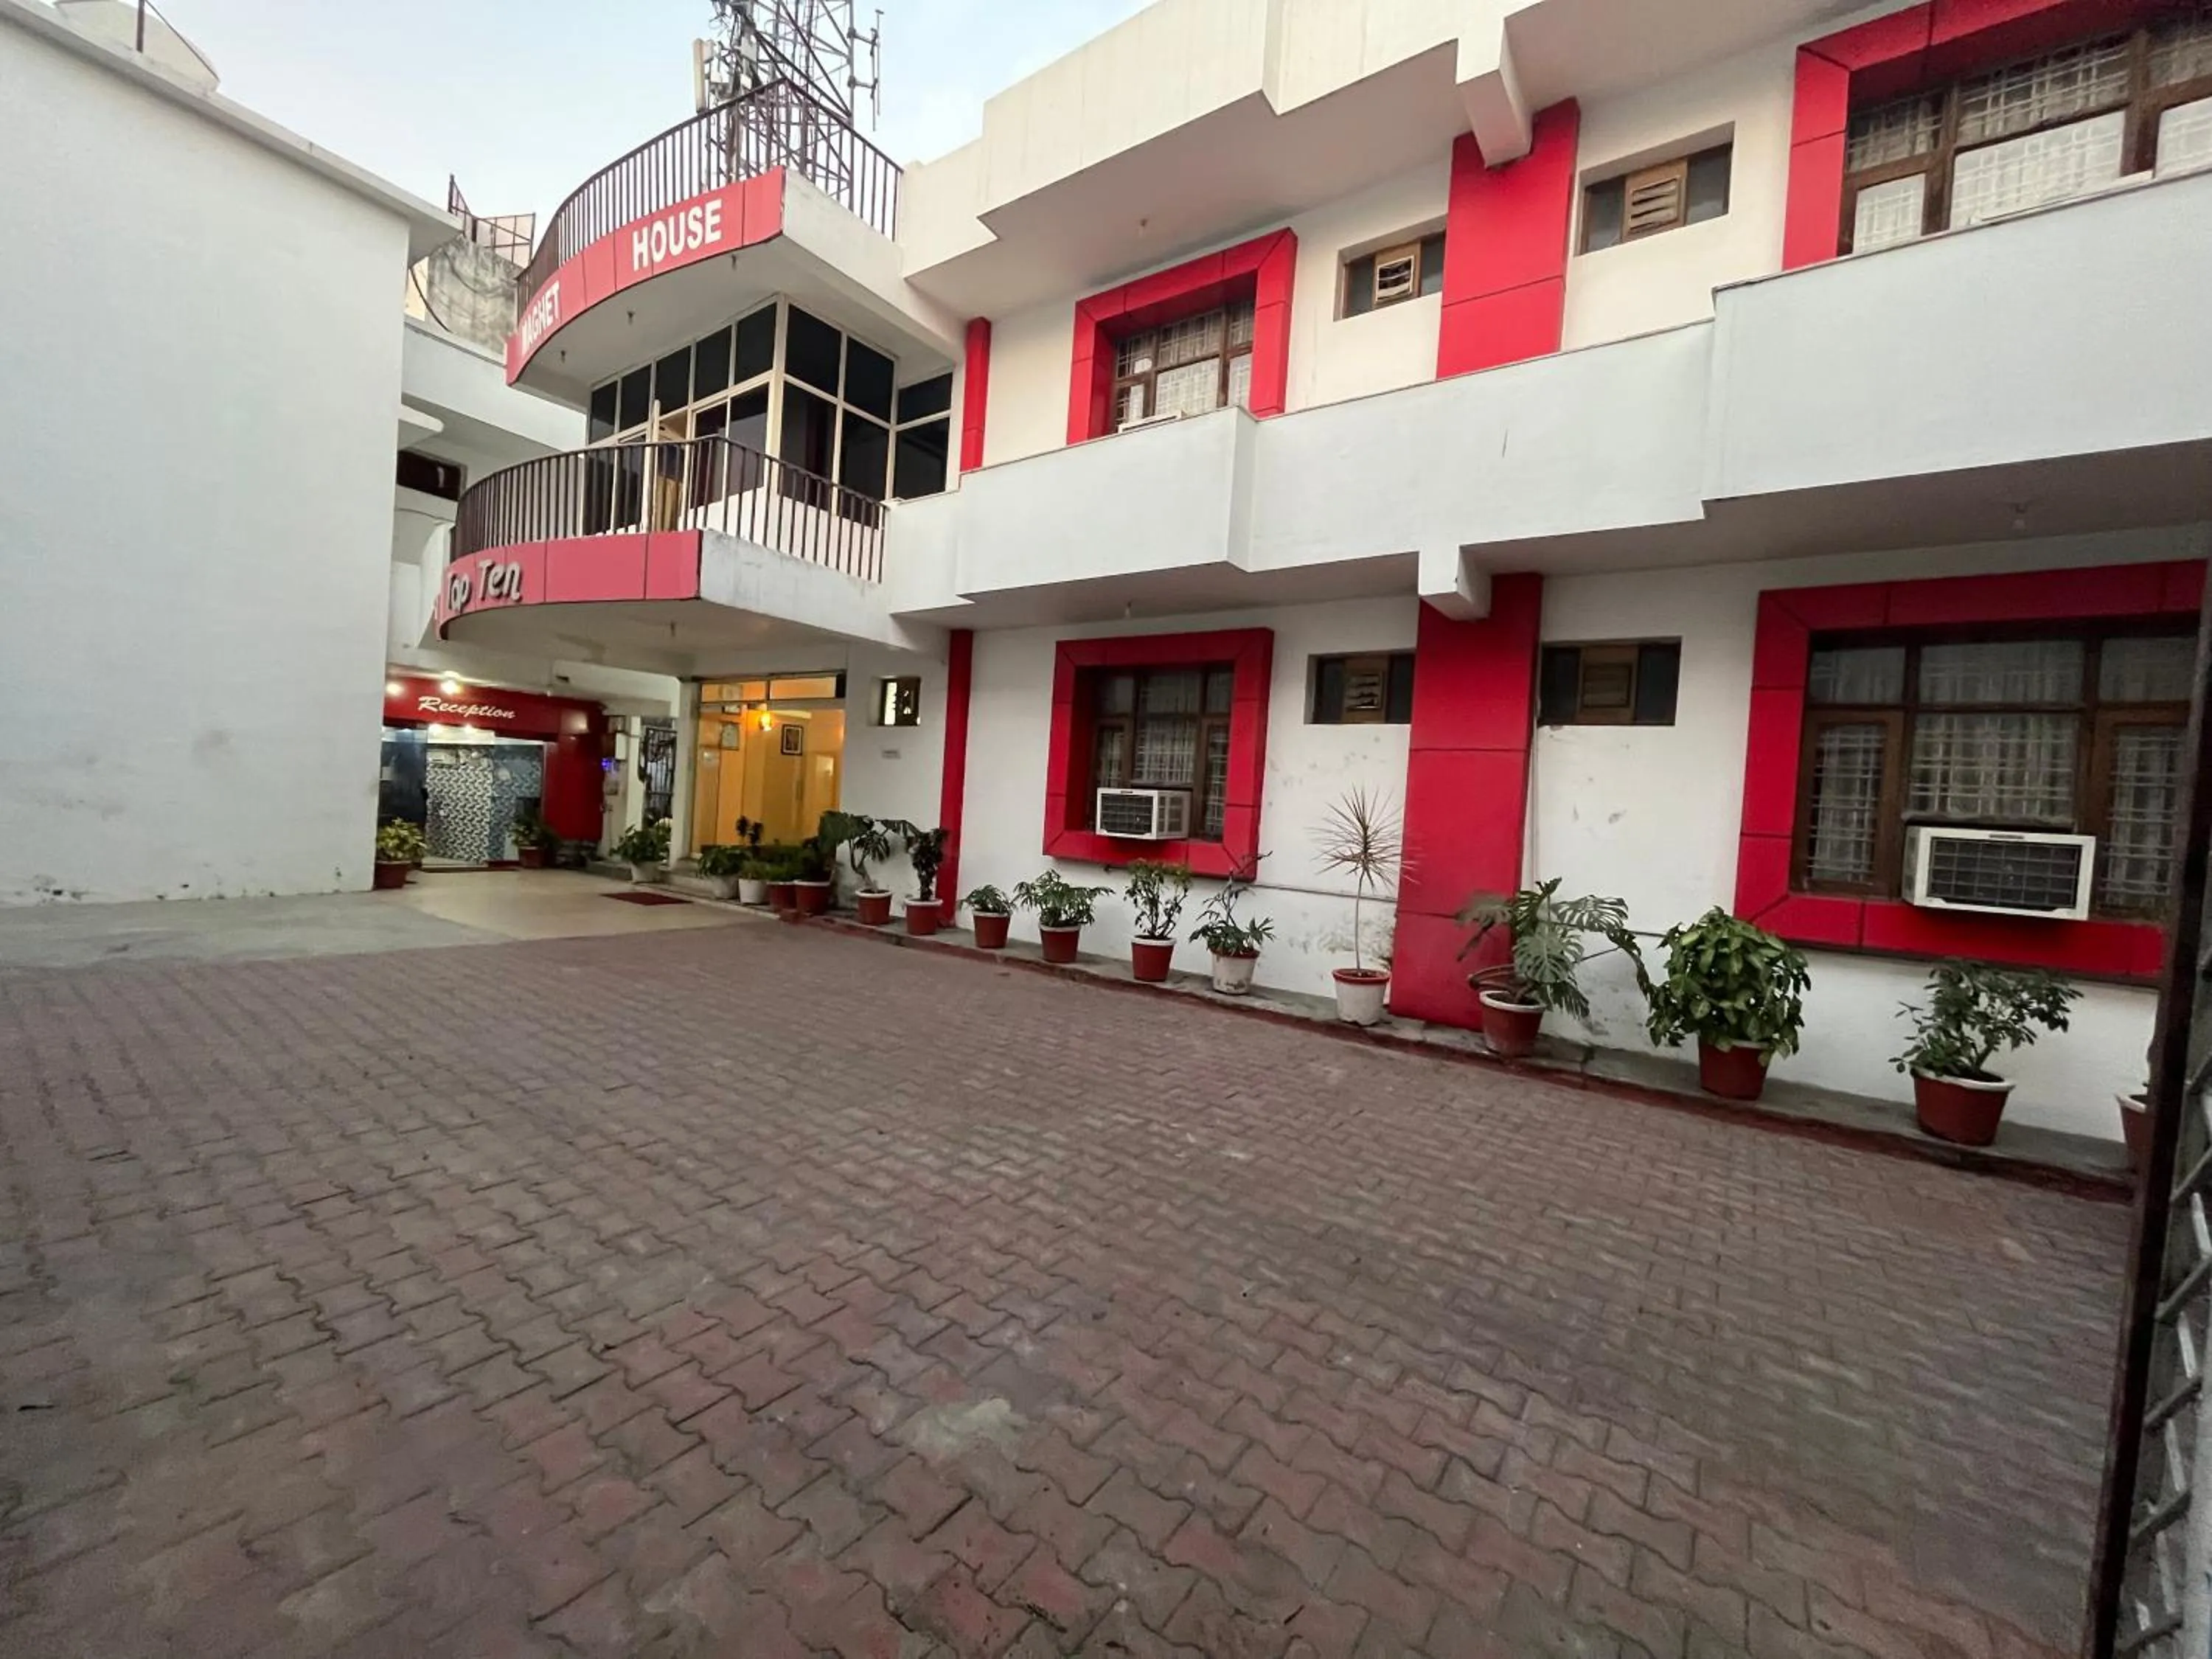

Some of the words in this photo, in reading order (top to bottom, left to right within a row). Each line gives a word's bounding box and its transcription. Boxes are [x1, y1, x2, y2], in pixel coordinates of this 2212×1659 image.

[633, 198, 722, 271] HOUSE
[447, 571, 470, 612] Top
[479, 559, 522, 601] Ten
[418, 696, 515, 719] Reception
